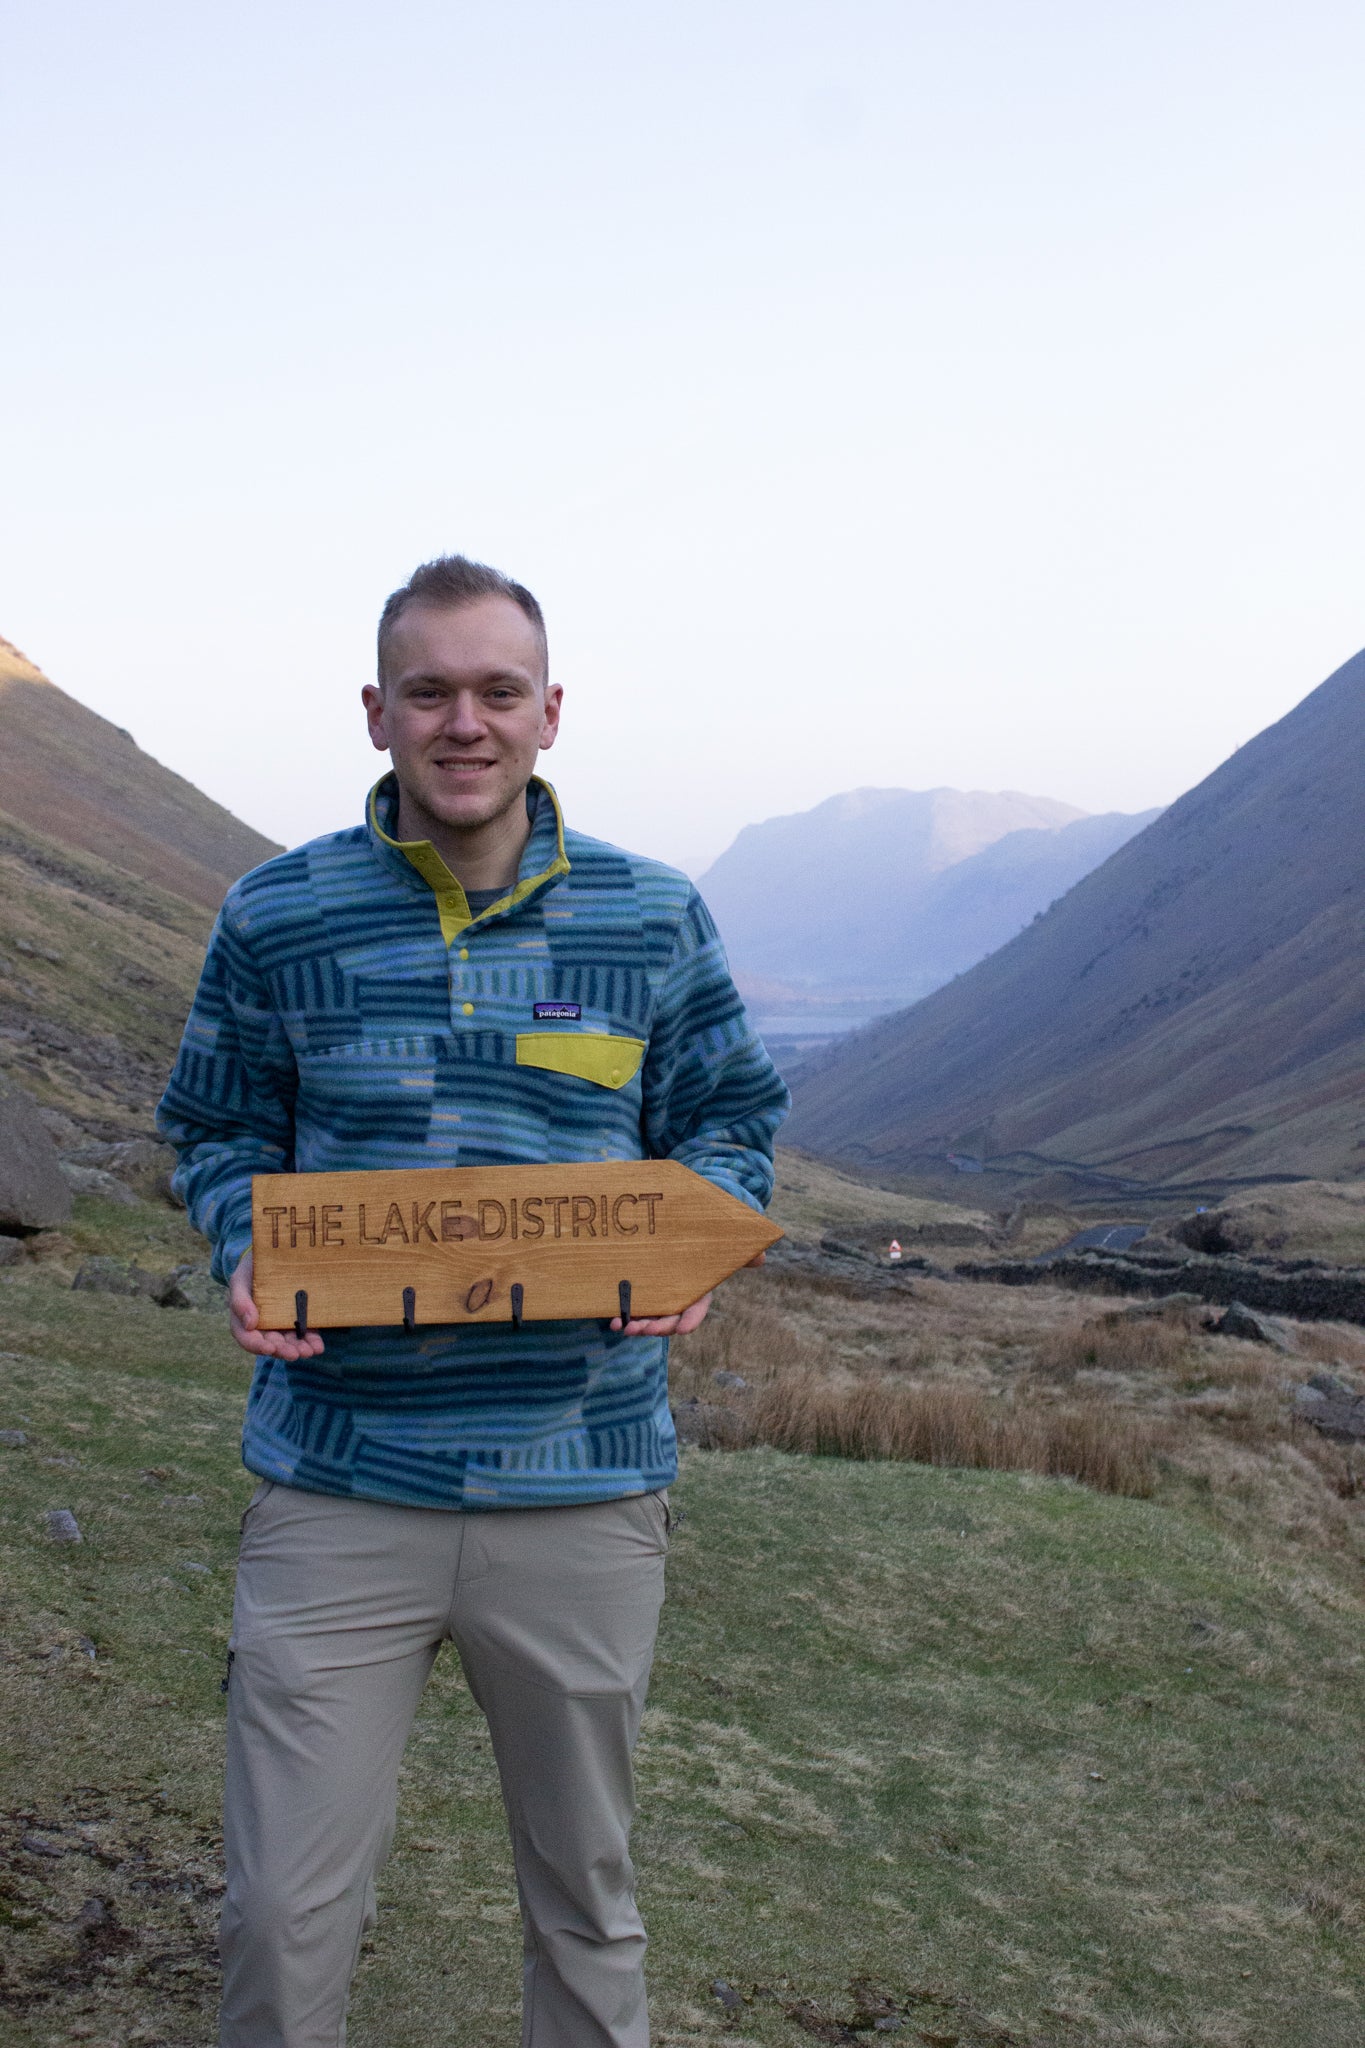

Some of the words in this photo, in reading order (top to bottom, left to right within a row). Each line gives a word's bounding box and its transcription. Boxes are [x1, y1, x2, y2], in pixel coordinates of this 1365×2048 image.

[263, 1204, 344, 1248] THE
[359, 1200, 464, 1245] LAKE
[478, 1193, 663, 1241] DISTRICT
